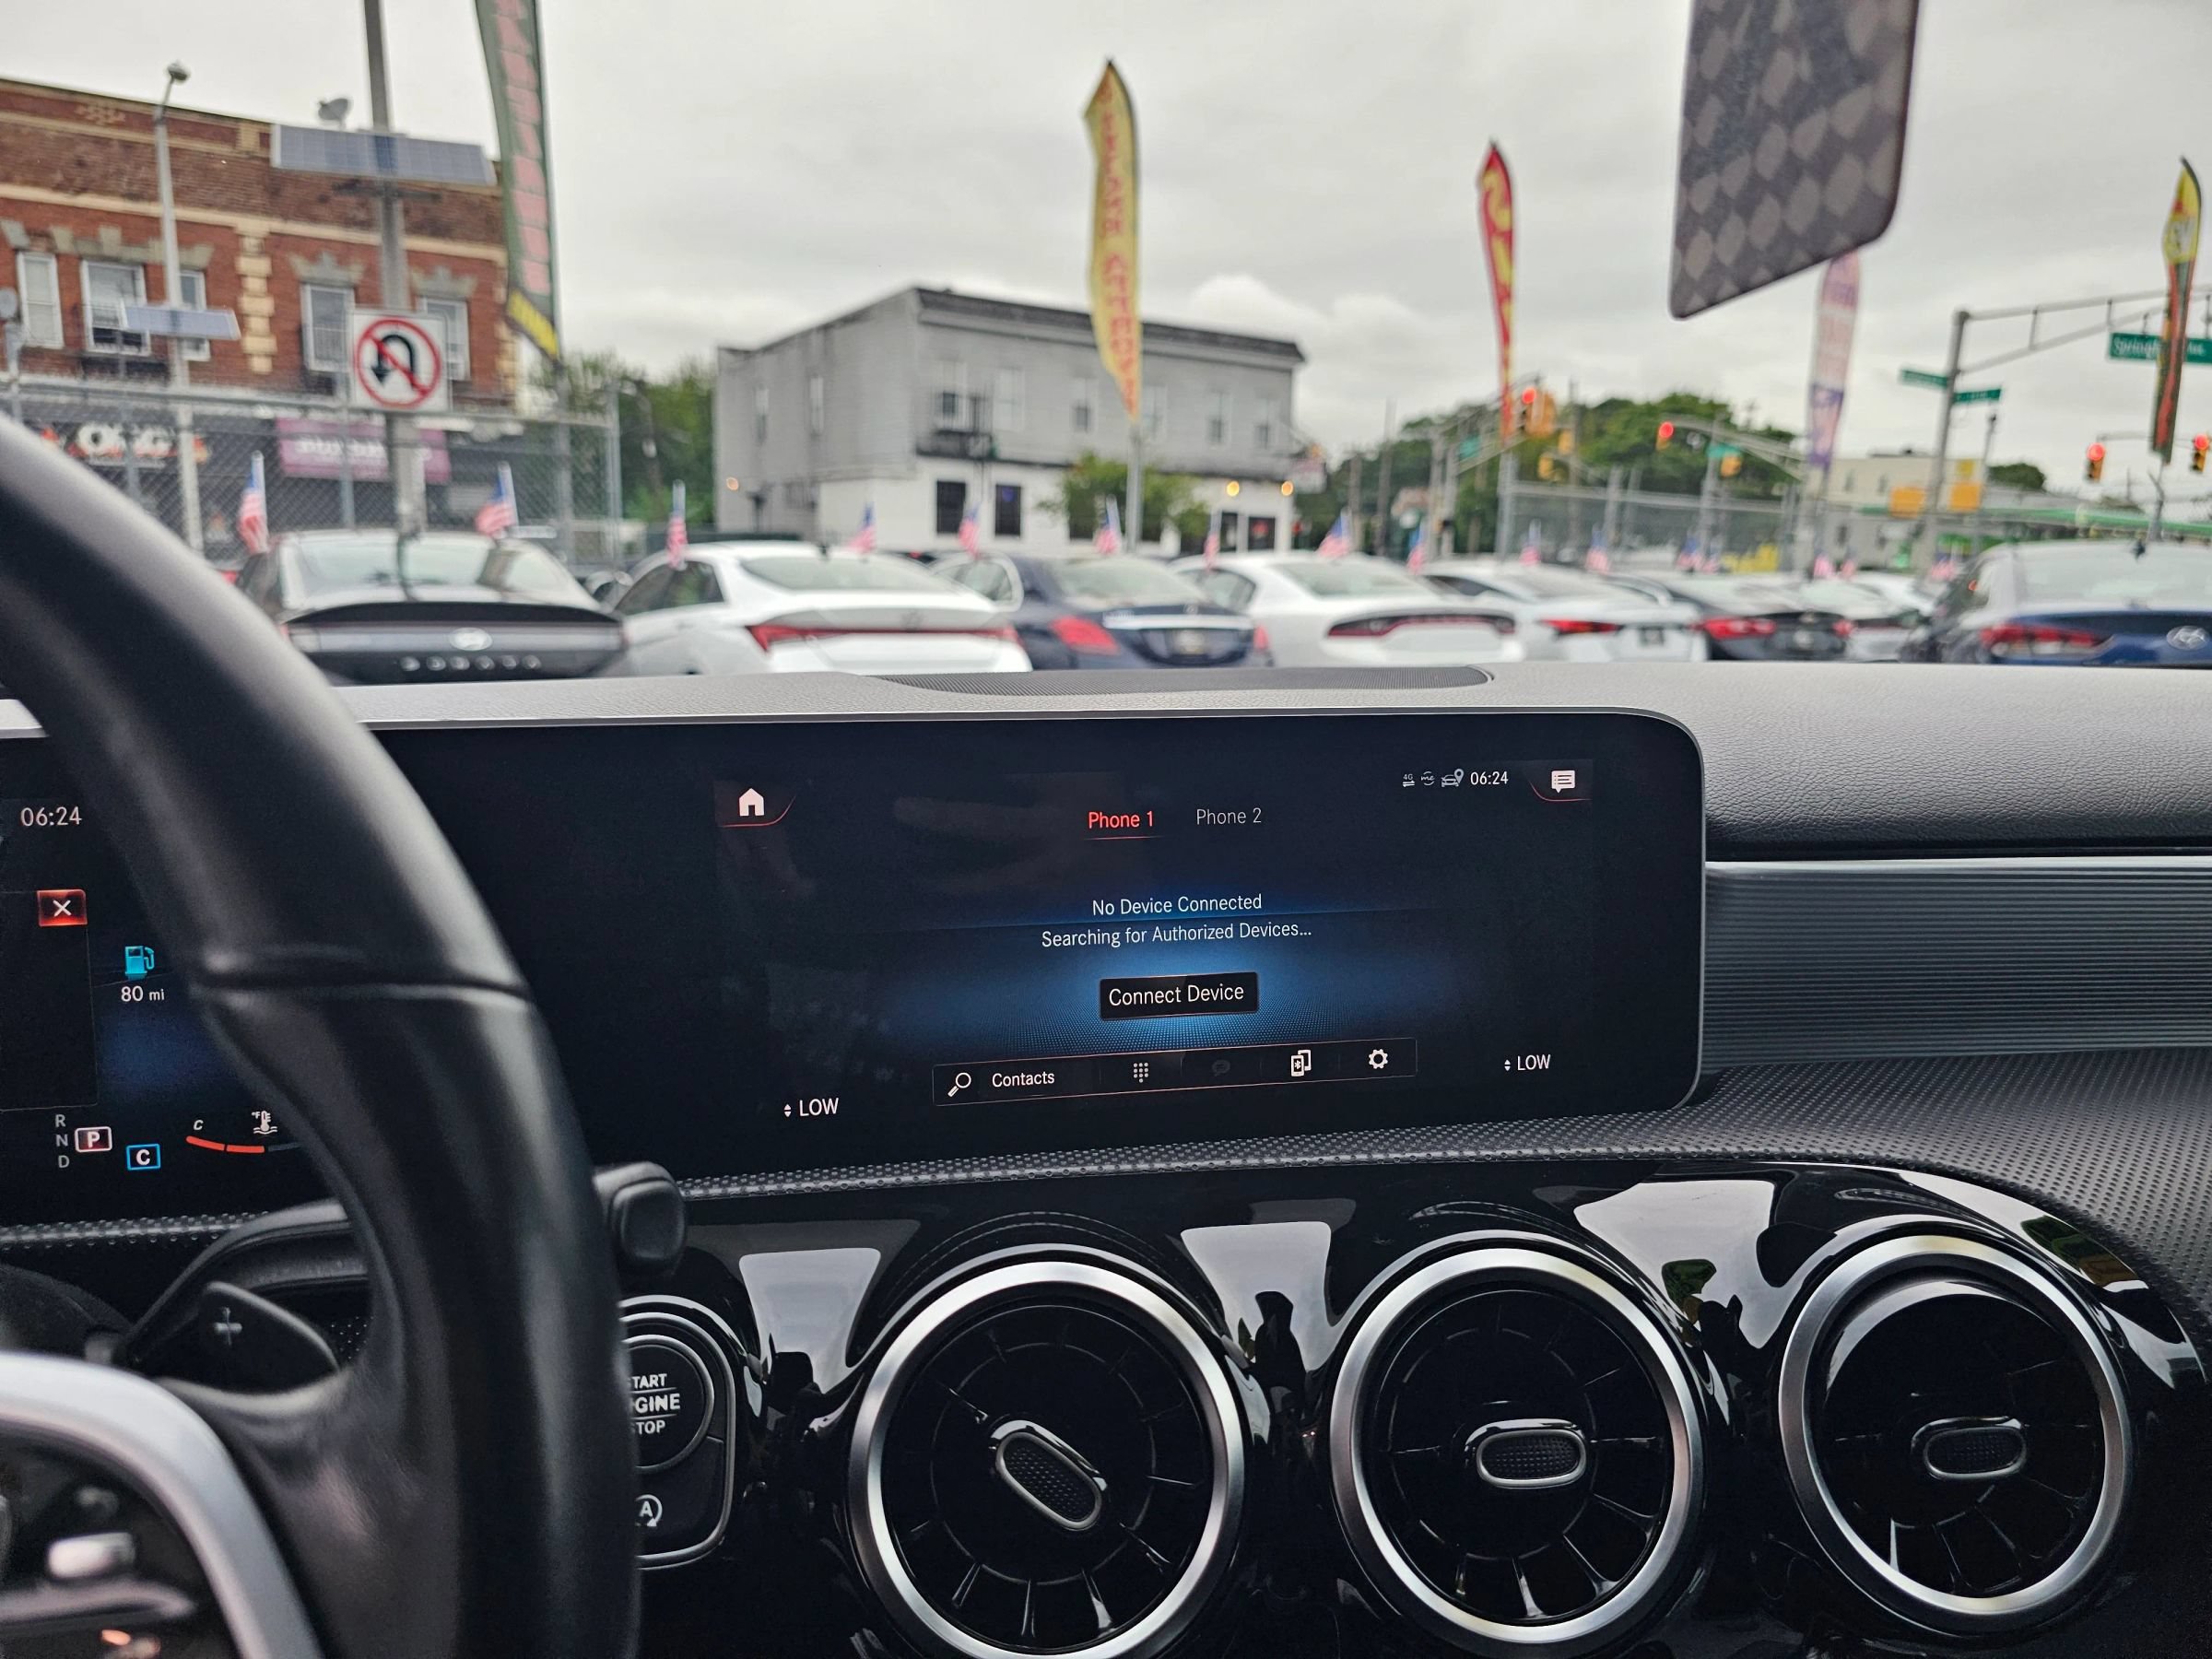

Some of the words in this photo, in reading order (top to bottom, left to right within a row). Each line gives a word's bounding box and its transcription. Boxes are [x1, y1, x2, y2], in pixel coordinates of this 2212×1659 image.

[1470, 771, 1509, 785] 06:24
[19, 806, 83, 827] 06:24
[1088, 811, 1140, 829] Phone
[1147, 810, 1154, 827] 1
[1195, 808, 1247, 826] Phone
[1253, 807, 1262, 824] 2
[1092, 899, 1115, 916] No
[1120, 897, 1173, 915] Device
[1178, 893, 1263, 912] Connected
[1041, 929, 1122, 948] Searching
[1124, 927, 1147, 944] for
[1152, 924, 1234, 942] Authorized
[1240, 921, 1312, 939] Devices...
[120, 985, 144, 1002] 80
[148, 989, 165, 1001] mi
[1109, 986, 1182, 1006] Connect
[1187, 982, 1244, 1003] Device
[1517, 1053, 1552, 1071] LOW
[992, 1070, 1055, 1088] Contacts
[799, 1097, 840, 1117] LOW
[55, 1113, 66, 1127] R
[193, 1119, 204, 1131] C
[55, 1134, 69, 1147] N
[87, 1131, 100, 1147] P
[58, 1155, 70, 1169] D
[135, 1149, 151, 1166] C
[630, 1393, 681, 1414] GINE
[631, 1419, 665, 1435] TOP
